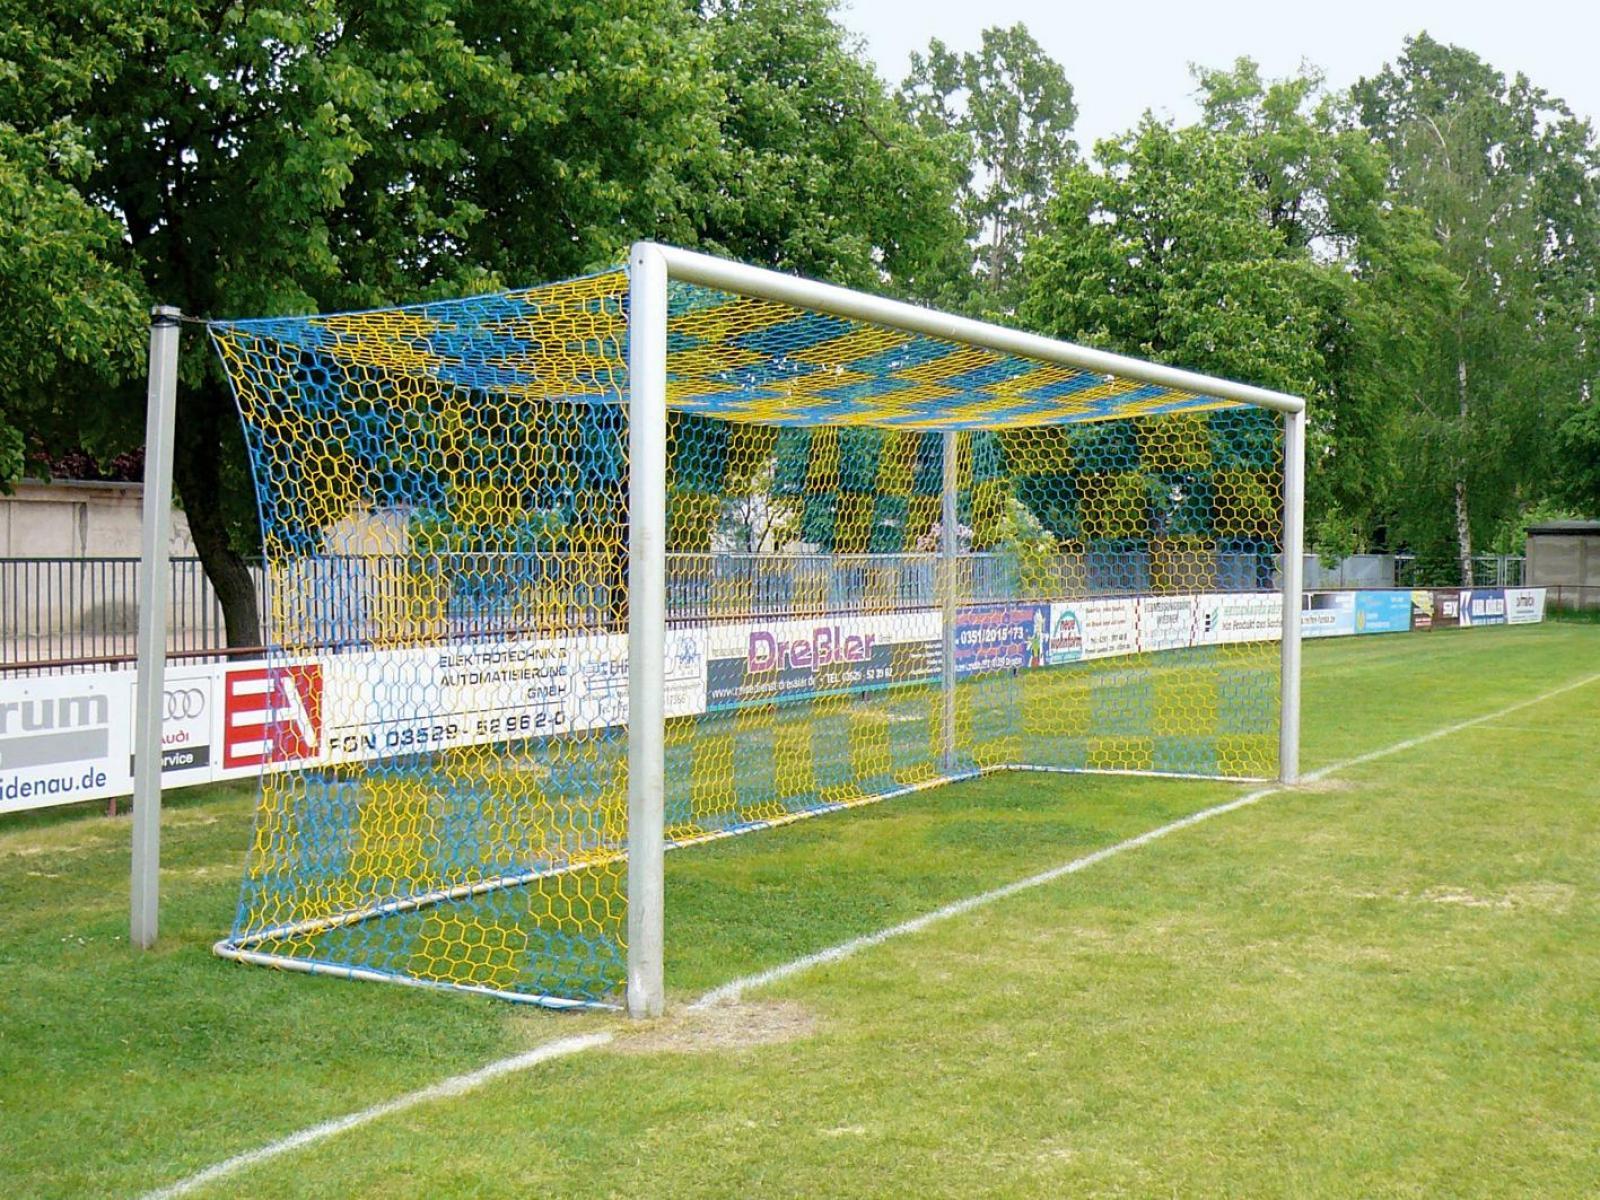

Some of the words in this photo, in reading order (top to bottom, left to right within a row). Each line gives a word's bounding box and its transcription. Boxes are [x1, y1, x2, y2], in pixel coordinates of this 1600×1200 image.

[439, 648, 556, 668] ELEKTROTECHNIK
[440, 665, 568, 687] AUTOMATISIERUNG
[329, 732, 376, 753] FON
[386, 724, 458, 747] 03529
[161, 752, 194, 766] rvice
